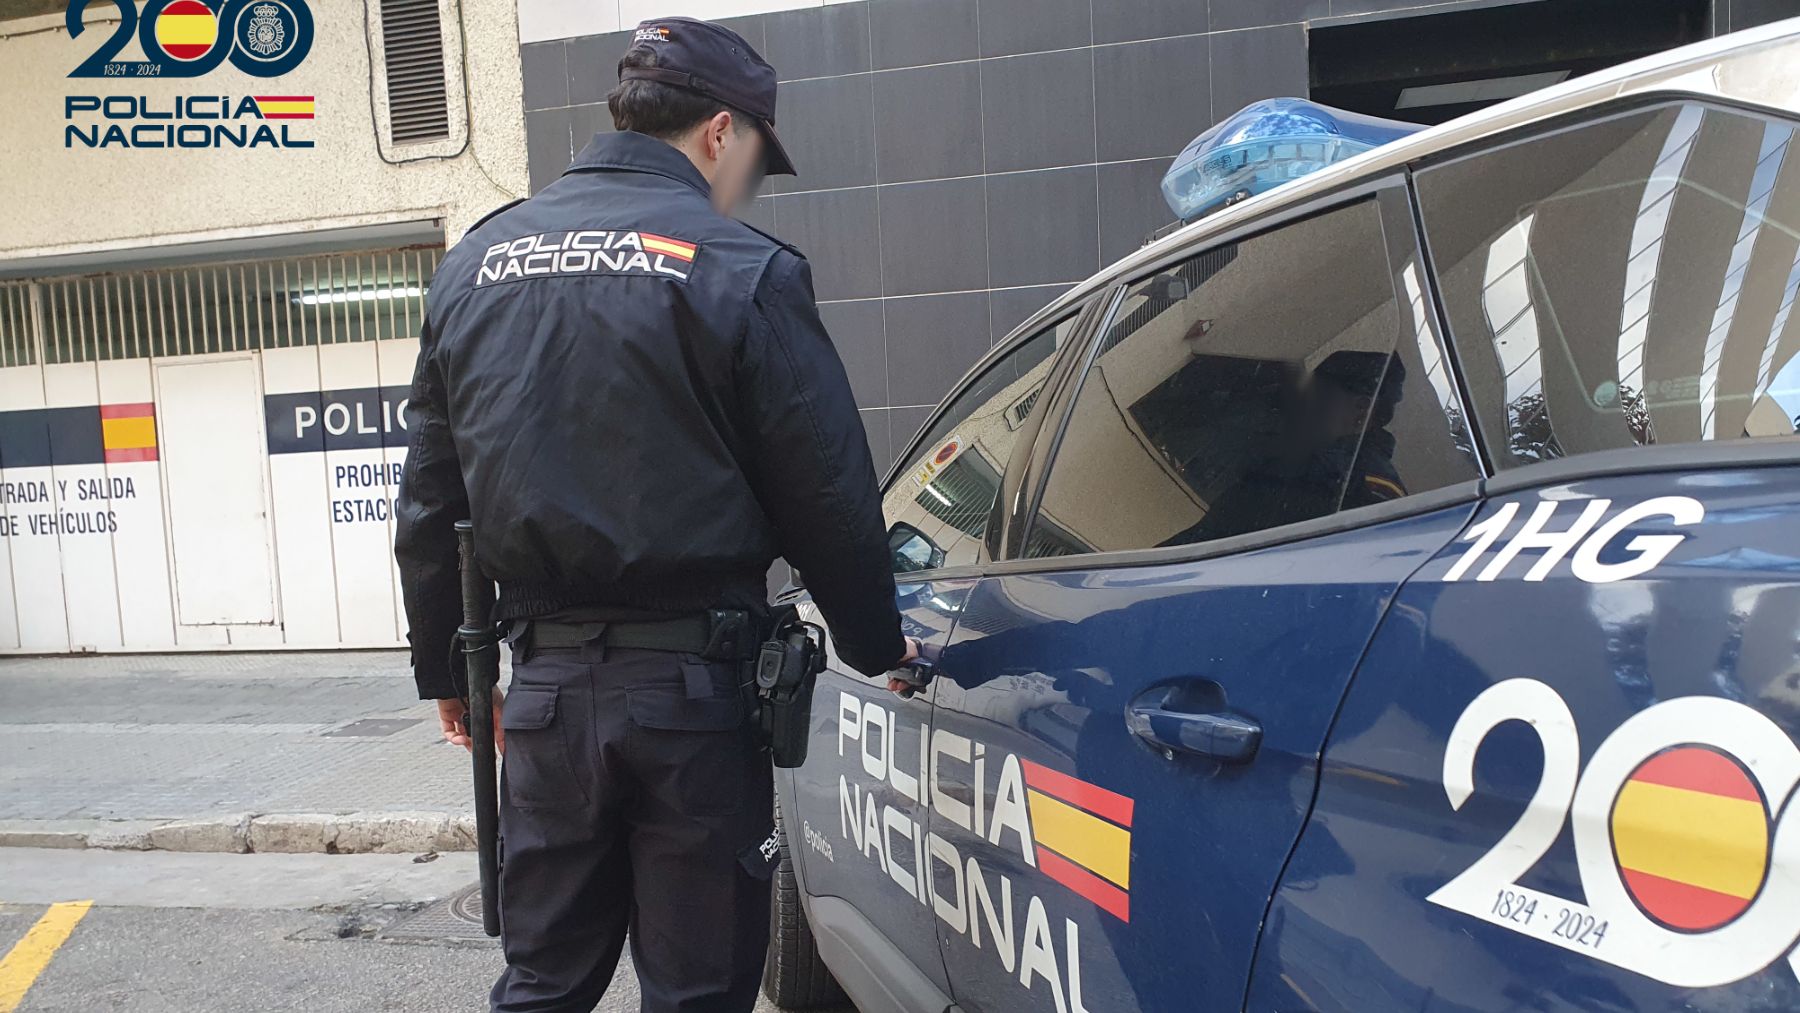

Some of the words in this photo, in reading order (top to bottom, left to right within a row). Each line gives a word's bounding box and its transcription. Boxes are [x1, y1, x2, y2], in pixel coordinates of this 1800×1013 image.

[476, 250, 687, 285] NACIONAL
[58, 480, 68, 502] Y
[77, 477, 136, 501] SALIDA
[0, 515, 20, 536] DE
[28, 507, 118, 536] VEHÍCULOS
[1442, 495, 1705, 583] 1HG
[1426, 678, 1800, 988] 20
[1491, 889, 1538, 925] 1824
[1552, 908, 1608, 949] 2024
